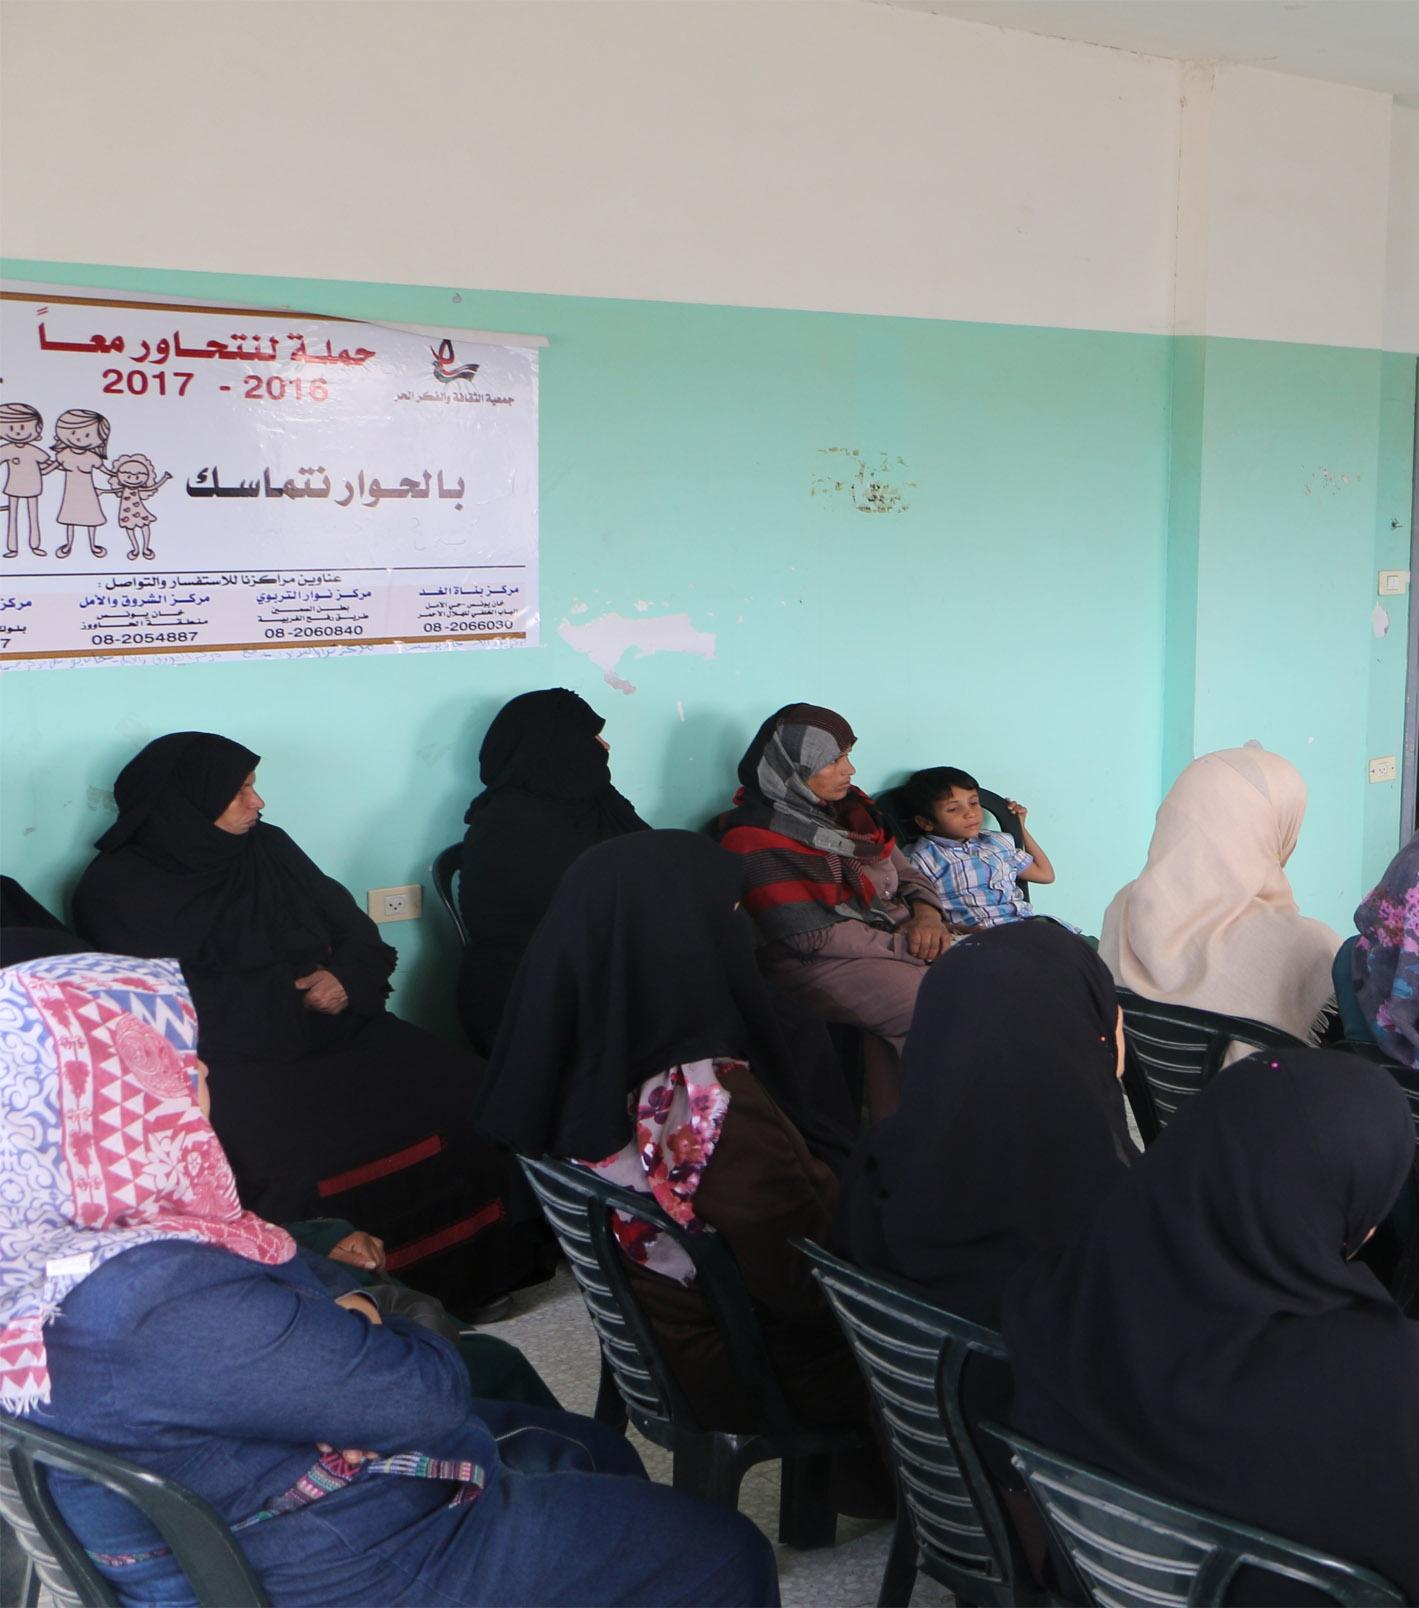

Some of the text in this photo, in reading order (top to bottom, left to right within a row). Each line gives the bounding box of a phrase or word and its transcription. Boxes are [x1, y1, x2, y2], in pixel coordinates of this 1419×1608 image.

[128, 330, 279, 365] لنتحاور
[286, 332, 377, 367] حملة
[102, 368, 194, 397] 2017
[243, 374, 329, 402] 2016
[186, 465, 466, 512] بالحوار نتماسك
[105, 575, 168, 590] والتواصل
[170, 575, 238, 590] للاستفسار
[241, 573, 295, 588] مراكزنا
[298, 573, 342, 587] عناوين
[170, 592, 211, 606] مركز
[256, 588, 372, 605] مركز نوار التربوي
[419, 585, 519, 598] مركز بناة الغد
[121, 593, 167, 608] الشروق
[151, 609, 185, 619] خان
[91, 631, 199, 646] 08-2054887
